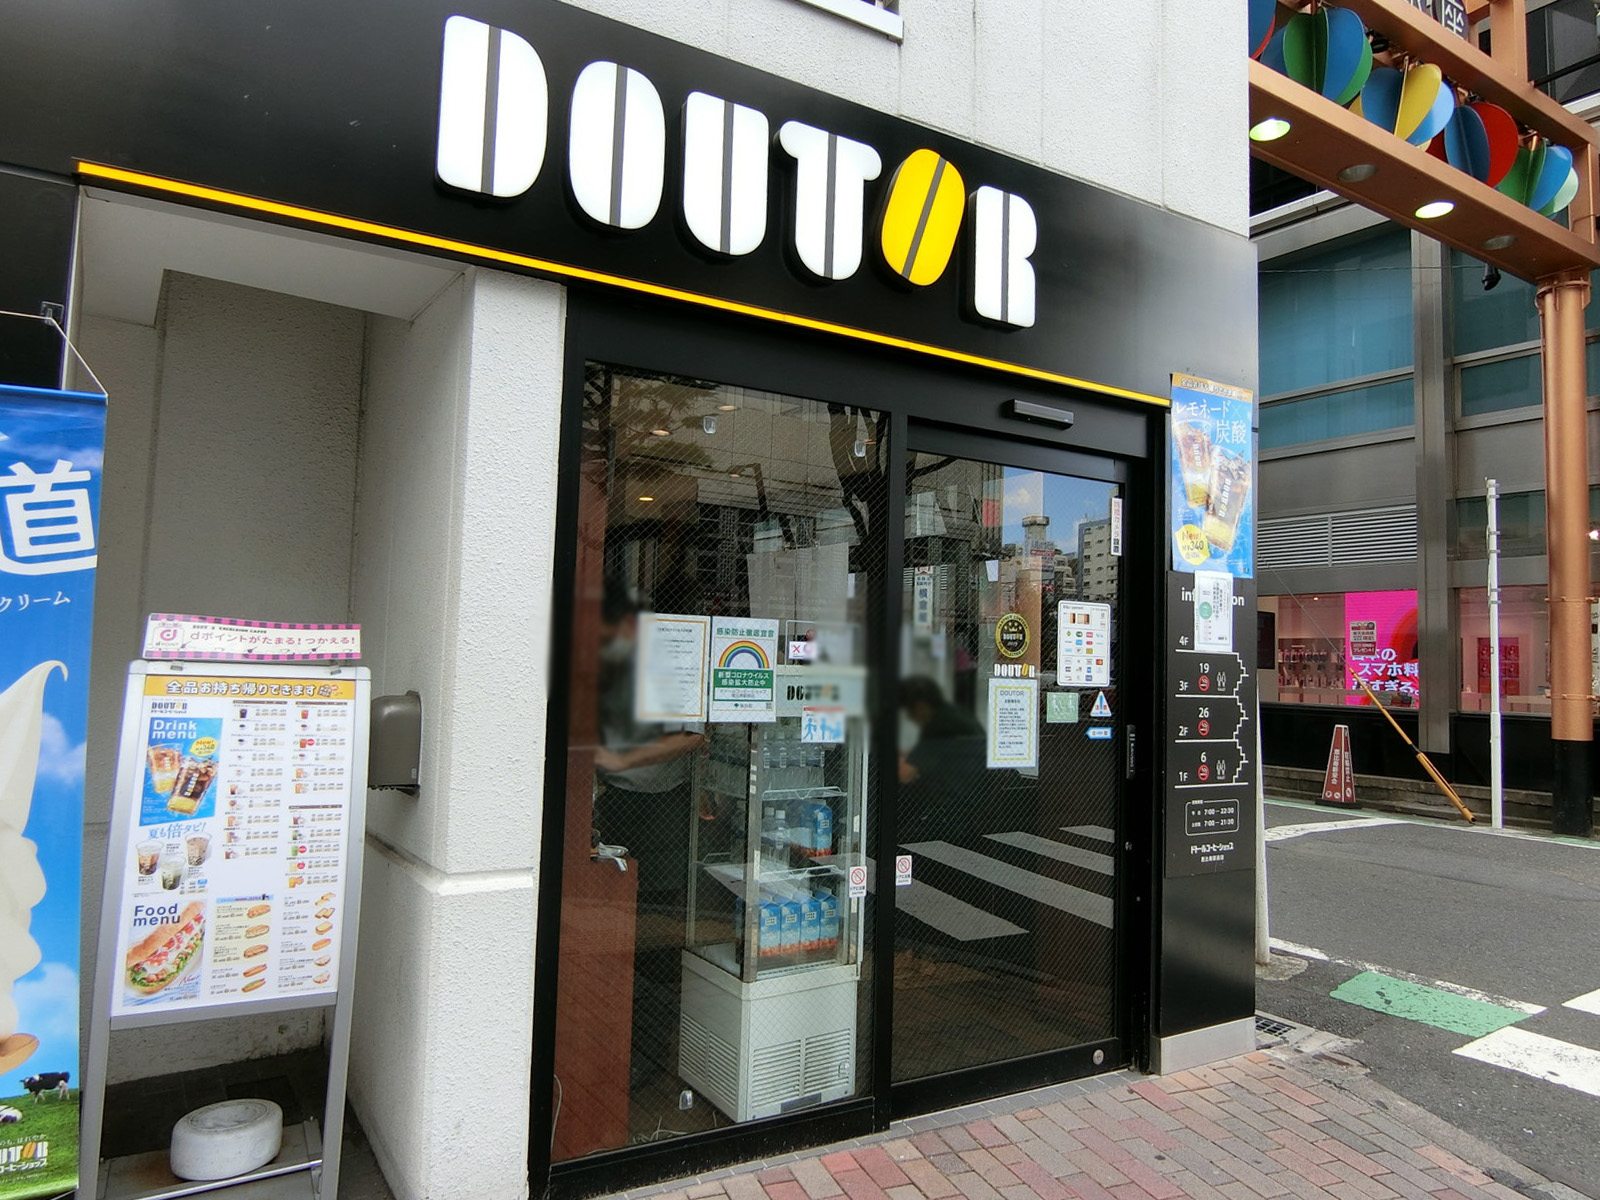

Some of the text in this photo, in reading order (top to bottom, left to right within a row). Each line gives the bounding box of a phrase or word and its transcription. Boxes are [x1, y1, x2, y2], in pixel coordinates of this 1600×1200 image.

[436, 15, 1037, 328] DOUTOR
[1215, 420, 1247, 444] 炭酸
[0, 459, 98, 575] 道
[0, 591, 71, 613] クリーム
[716, 627, 774, 638] 感染防止徹底宣言
[1179, 635, 1189, 646] 4F
[993, 663, 1036, 678] DOUTOR
[1199, 662, 1210, 674] 19
[718, 671, 769, 679] 新型コロナウイルス
[166, 680, 317, 697] 全品お持ち帰りできます
[721, 679, 766, 687] 感染拡大防止中
[1179, 680, 1189, 691] 3F
[1198, 707, 1209, 718] 26
[153, 719, 197, 731] Drink
[1178, 725, 1188, 737] 2F
[152, 729, 197, 740] menu
[1200, 752, 1207, 763] 6
[1178, 771, 1188, 782] 1F
[134, 903, 178, 917] Food
[132, 915, 181, 928] menu
